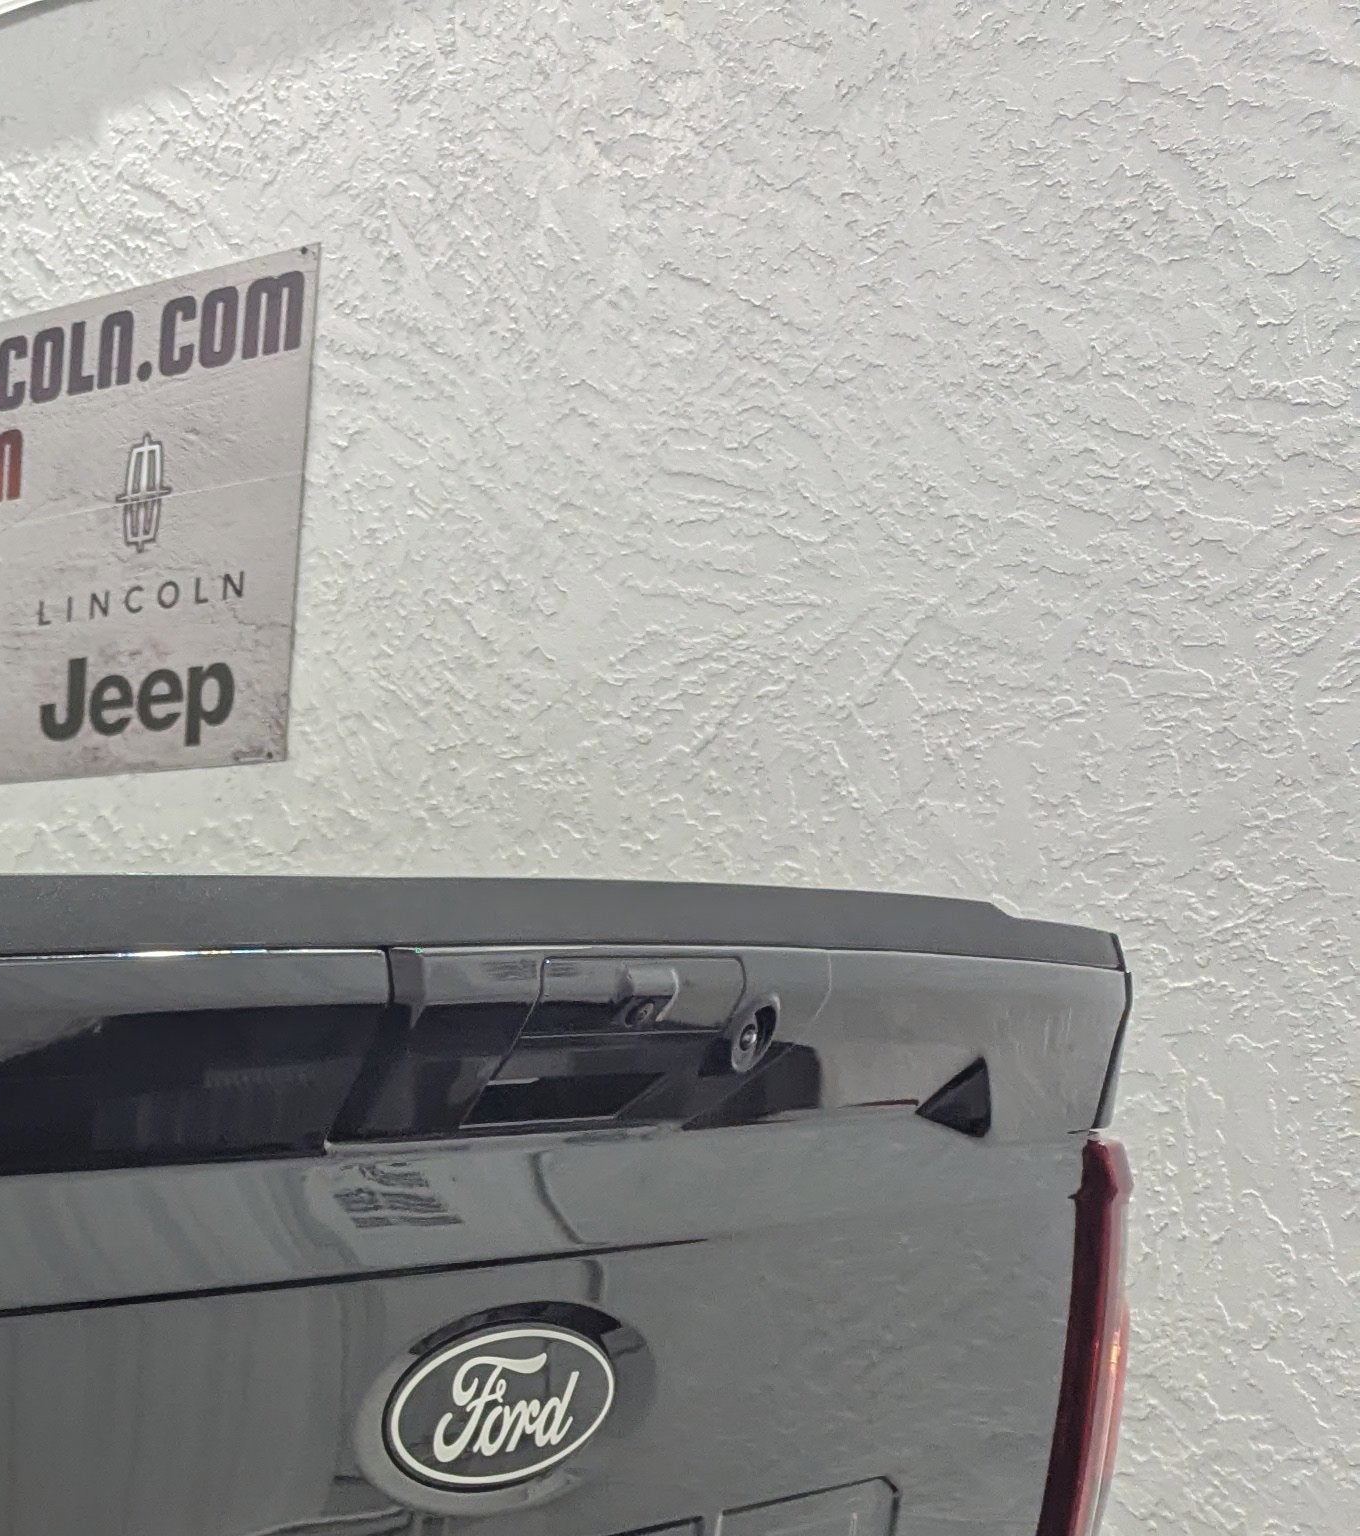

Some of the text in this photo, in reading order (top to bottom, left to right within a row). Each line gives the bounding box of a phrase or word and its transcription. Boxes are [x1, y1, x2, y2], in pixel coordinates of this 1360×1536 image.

[36, 570, 246, 627] LINCOLN
[38, 656, 236, 748] Jeep
[432, 1351, 581, 1463] Ford
